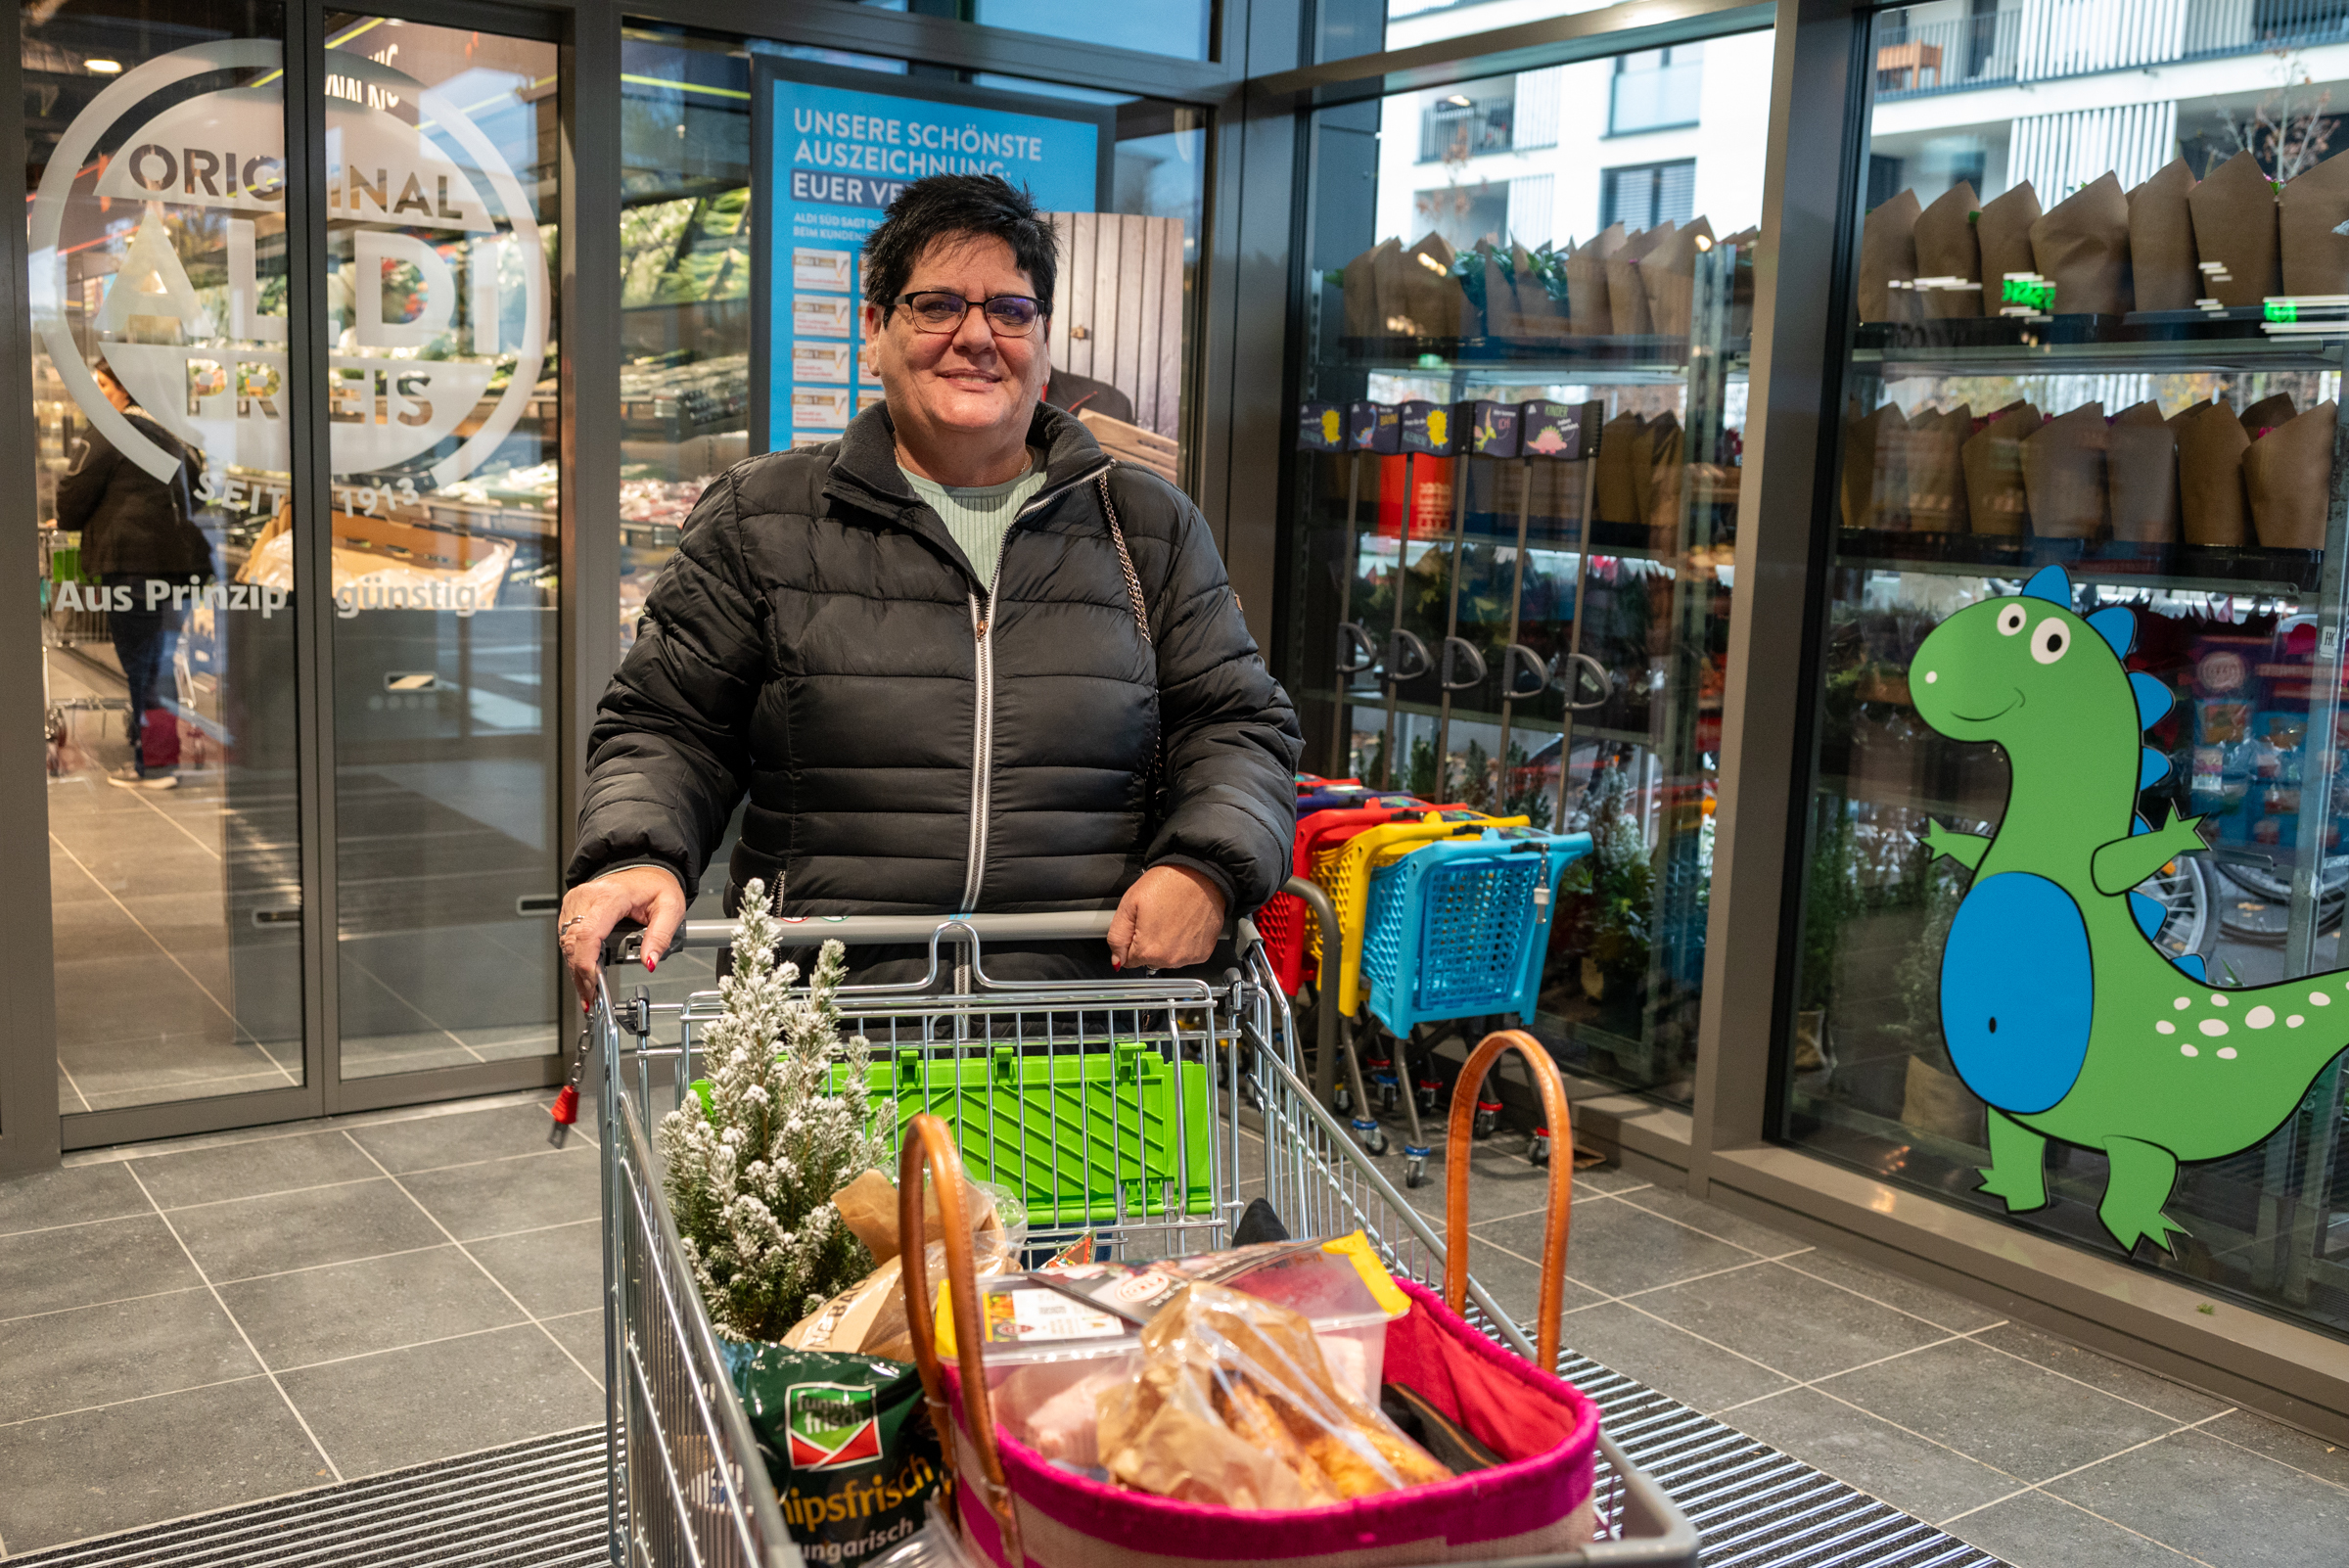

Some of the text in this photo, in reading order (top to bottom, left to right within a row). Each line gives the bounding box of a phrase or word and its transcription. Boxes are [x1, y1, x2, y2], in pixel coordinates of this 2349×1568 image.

[794, 107, 1042, 161] UNSERE SCHÖNSTE
[128, 143, 463, 220] ORIGINAL
[793, 171, 863, 204] EUER
[793, 212, 818, 224] ALDI
[819, 213, 840, 227] SÜD
[841, 216, 866, 229] SAGT
[92, 202, 500, 354] ALDI
[185, 357, 435, 427] PREIS
[193, 472, 420, 519] SEIT 1913
[53, 575, 487, 620] Aus Prinzip günstig.
[772, 1453, 936, 1533] hipsfrisch
